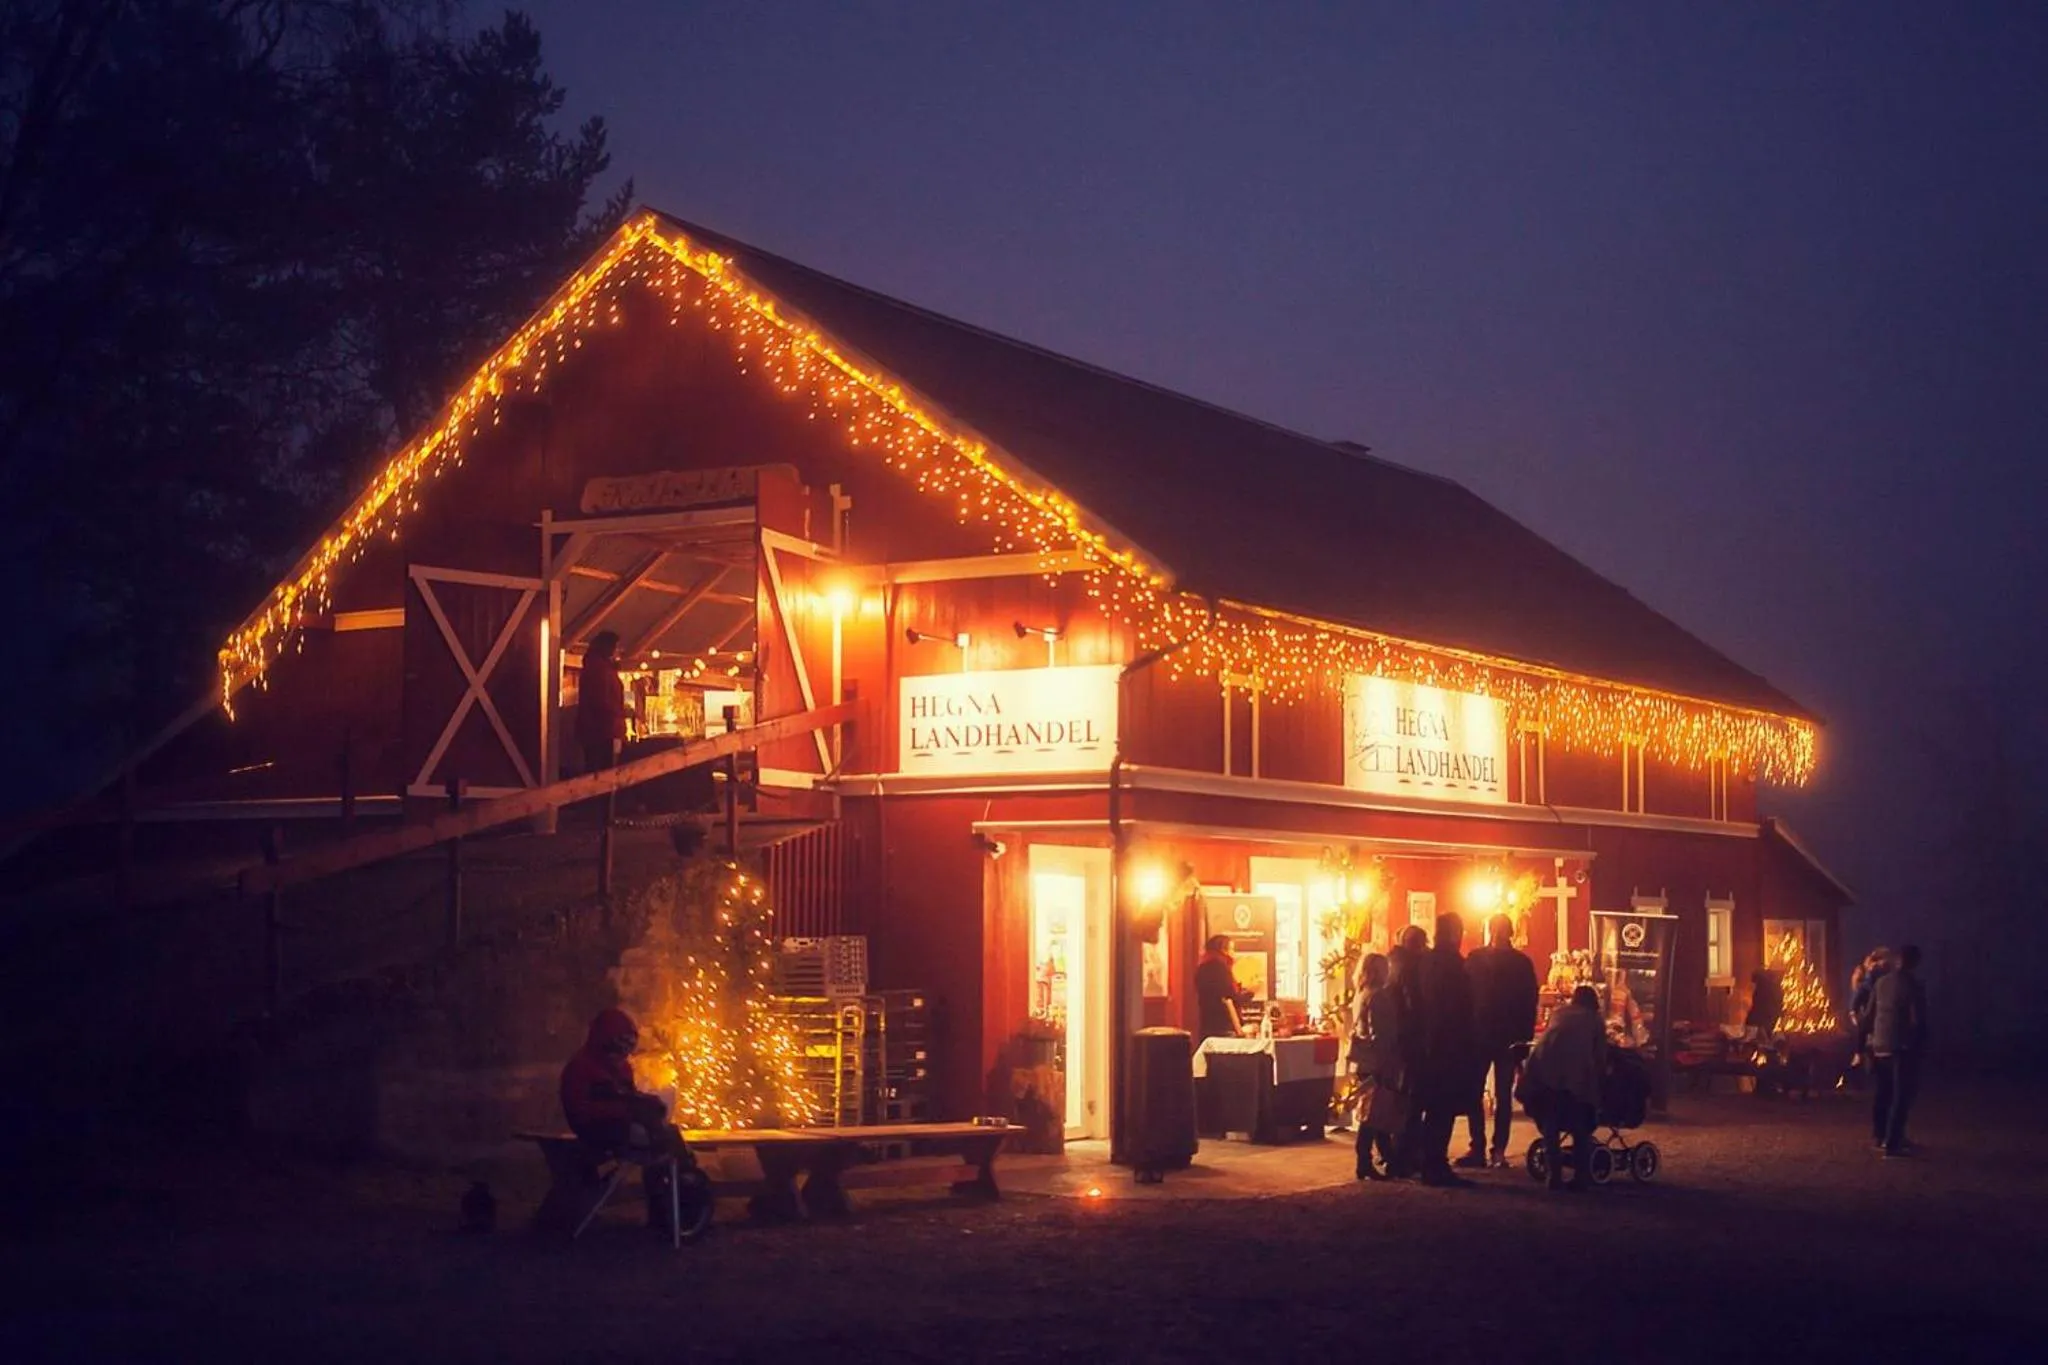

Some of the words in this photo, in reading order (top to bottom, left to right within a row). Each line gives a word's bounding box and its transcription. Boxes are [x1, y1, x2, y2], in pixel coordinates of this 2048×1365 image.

[910, 693, 1002, 719] HEGNA
[910, 719, 1100, 750] LANDHANDEL
[1396, 706, 1449, 741] HEGNA
[1396, 746, 1498, 783] LANDHANDEL
